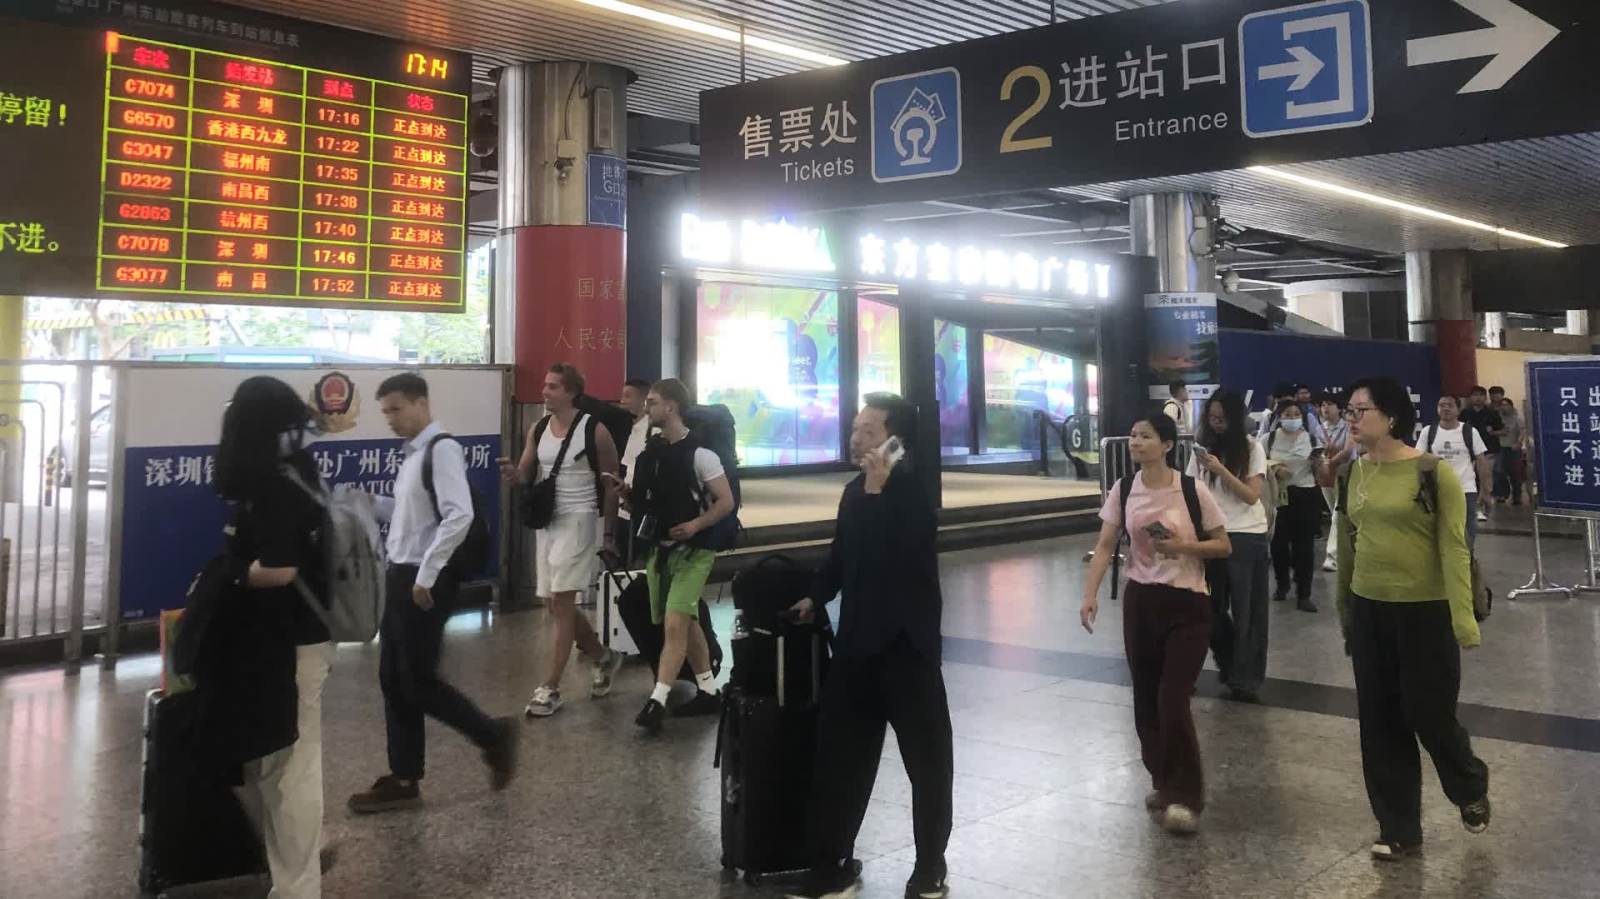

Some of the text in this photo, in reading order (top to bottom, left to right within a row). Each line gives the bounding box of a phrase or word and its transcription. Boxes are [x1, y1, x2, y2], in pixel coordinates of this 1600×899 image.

[406, 53, 448, 79] 17:14
[124, 78, 175, 99] C7074
[318, 108, 360, 126] 17:16
[393, 118, 447, 139] 正点到达
[1000, 38, 1226, 153] 2 进站口
[123, 109, 447, 165] G6570 香港西九龙 17:22 正点到达
[738, 100, 858, 160] 售票处
[1116, 111, 1228, 141] Entrance
[122, 140, 445, 192] G3047 福州南 17:35 正点到达
[781, 157, 855, 183] Tickets
[120, 172, 445, 218] D2322 南昌西 17:38 正点到达
[220, 211, 269, 231] 杭州西
[314, 221, 357, 237] 17:40
[390, 226, 445, 245] 正点到达
[117, 234, 170, 253] C7078
[312, 249, 356, 265] 17:46
[389, 253, 444, 271] 正点到达
[116, 266, 443, 298] G3077 南昌 17:52 正点到达
[1560, 387, 1584, 486] 只出不进
